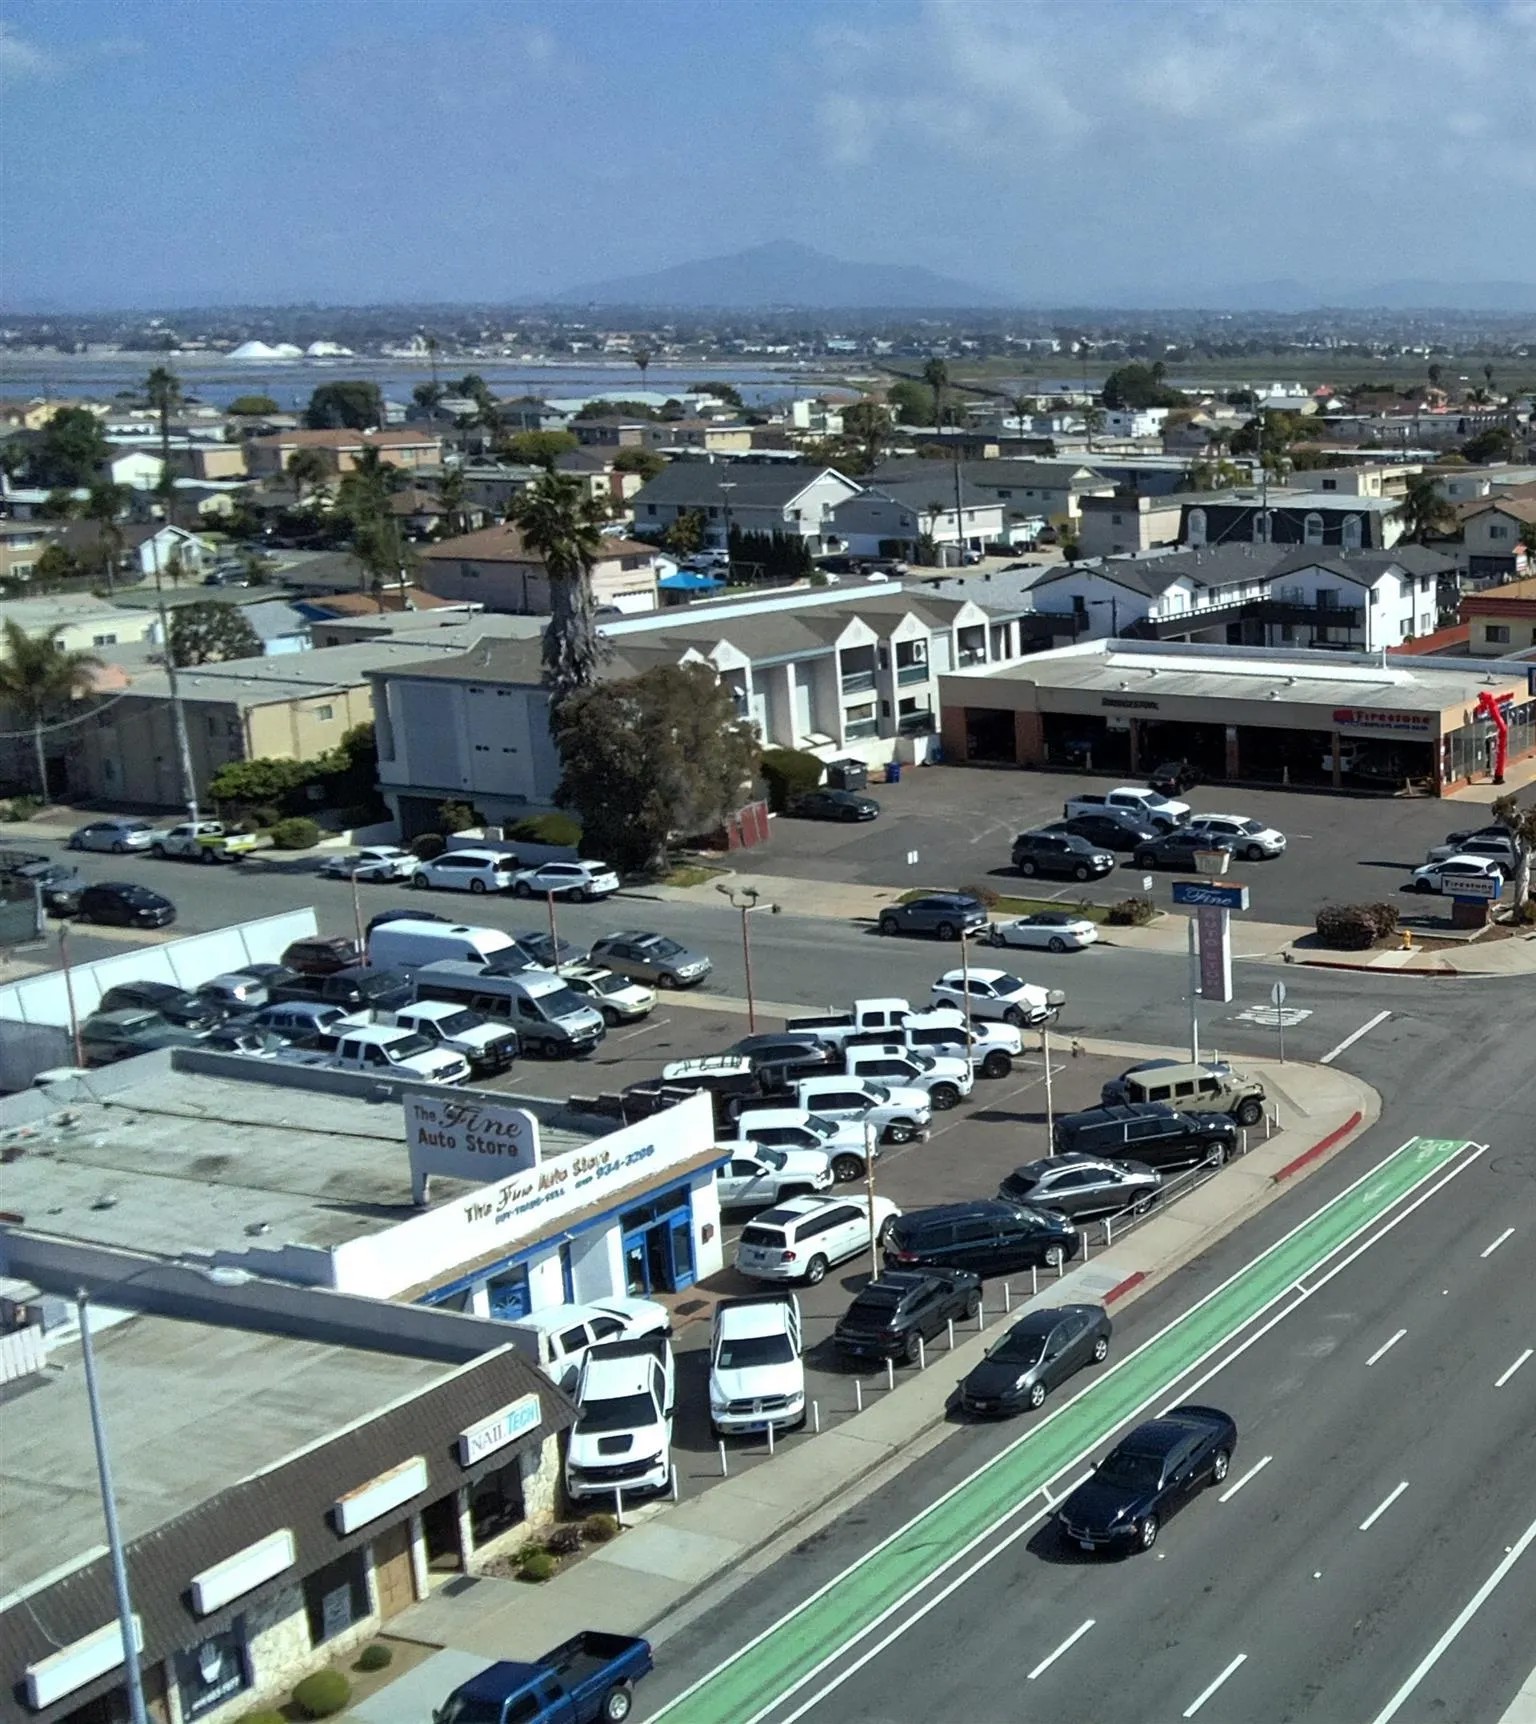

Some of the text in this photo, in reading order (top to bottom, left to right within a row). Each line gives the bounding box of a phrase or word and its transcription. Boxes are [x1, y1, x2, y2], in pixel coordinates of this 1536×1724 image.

[1357, 710, 1430, 725] Firestone
[1182, 886, 1232, 906] Fine
[1445, 879, 1493, 891] Firestone
[413, 1100, 522, 1139] The Fine
[418, 1128, 519, 1157] Auto Store
[464, 1203, 492, 1224] The
[538, 1167, 568, 1192] Auto
[572, 1151, 610, 1177] Store
[507, 1403, 536, 1435] TECH
